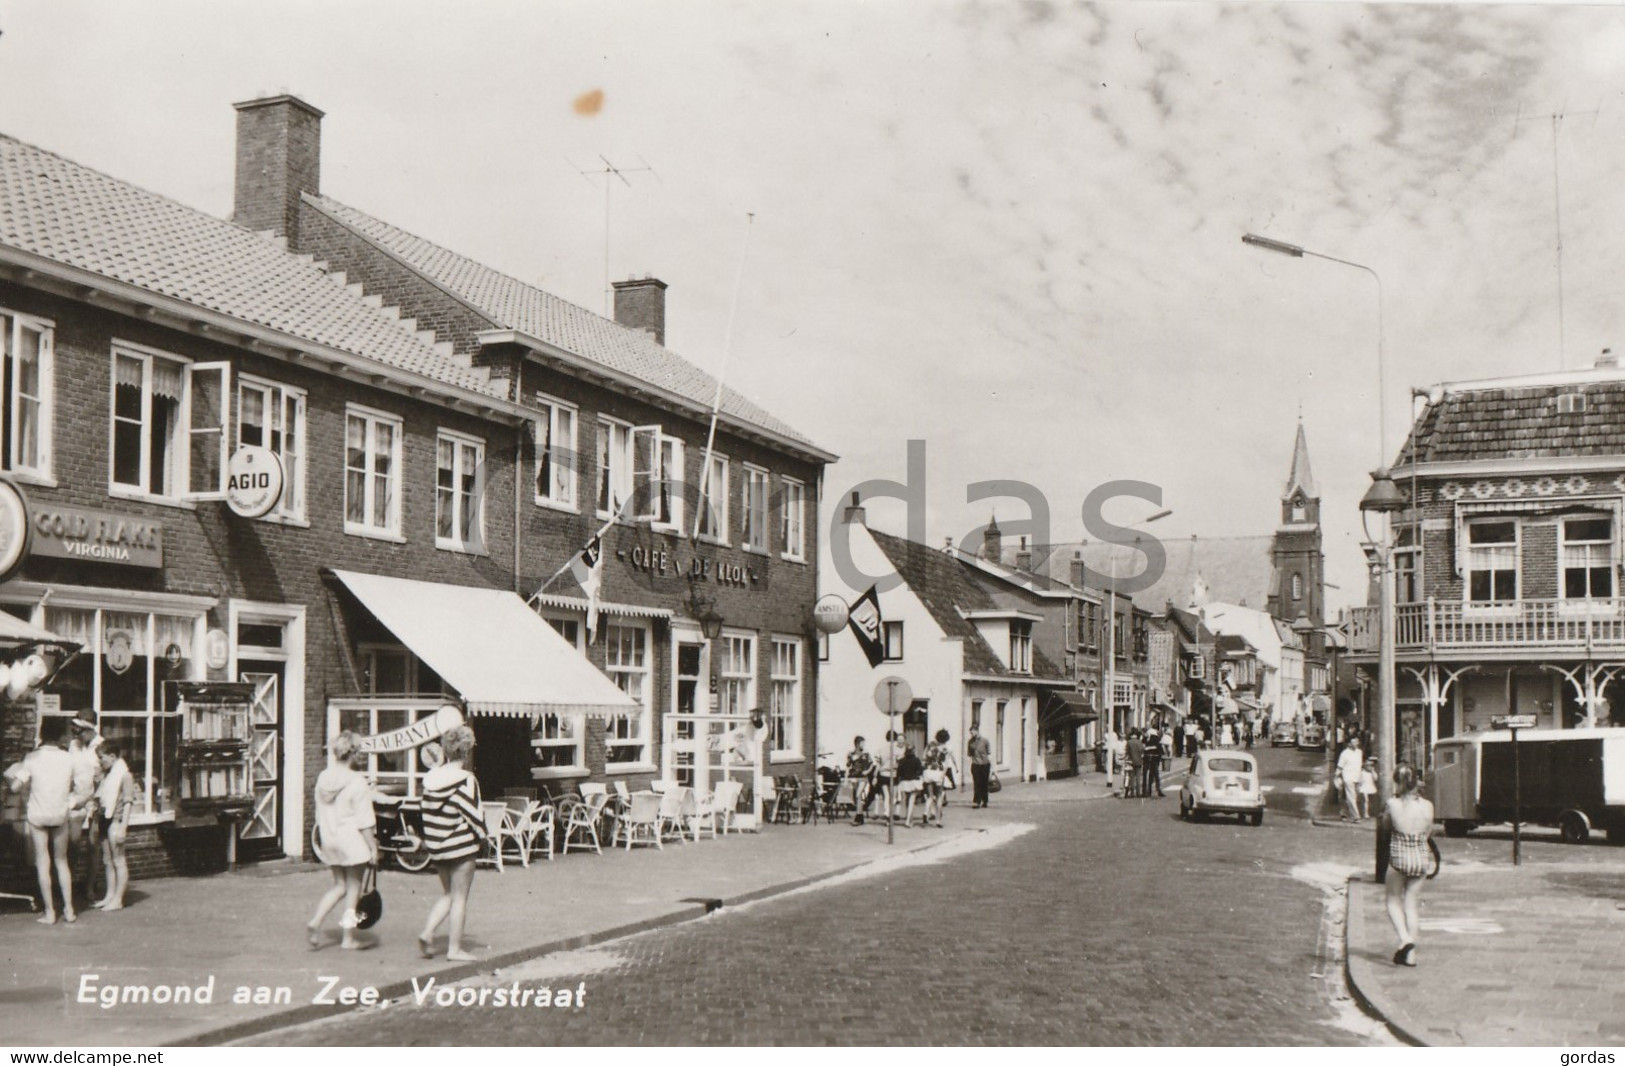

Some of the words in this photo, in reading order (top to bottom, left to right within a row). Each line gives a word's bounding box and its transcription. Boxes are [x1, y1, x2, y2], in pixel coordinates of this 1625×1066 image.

[228, 473, 269, 490] AGIO
[62, 541, 130, 560] VIRGINIA
[632, 543, 667, 570] CAFÉ
[693, 557, 710, 576] DE
[717, 561, 748, 584] KLOK
